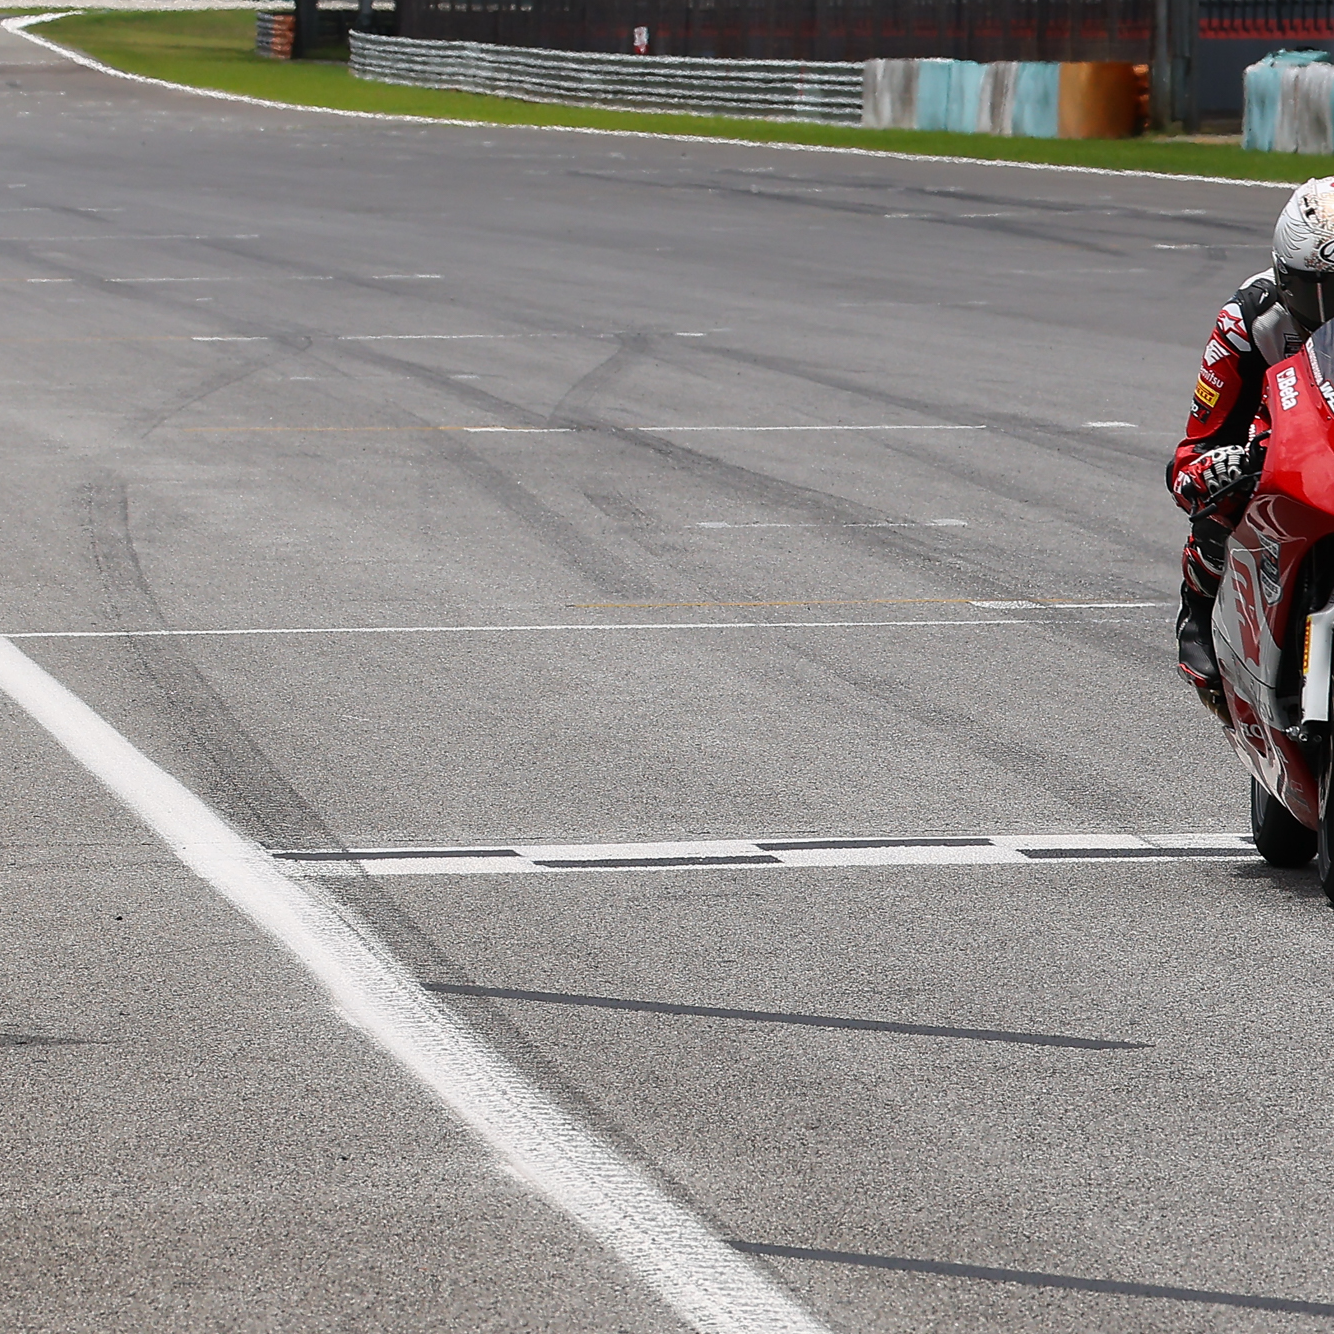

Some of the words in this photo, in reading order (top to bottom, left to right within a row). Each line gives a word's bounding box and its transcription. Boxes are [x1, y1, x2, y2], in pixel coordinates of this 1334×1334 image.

[1200, 365, 1224, 388] mitsu
[1278, 375, 1299, 411] Beta
[1239, 715, 1288, 764] HOA
